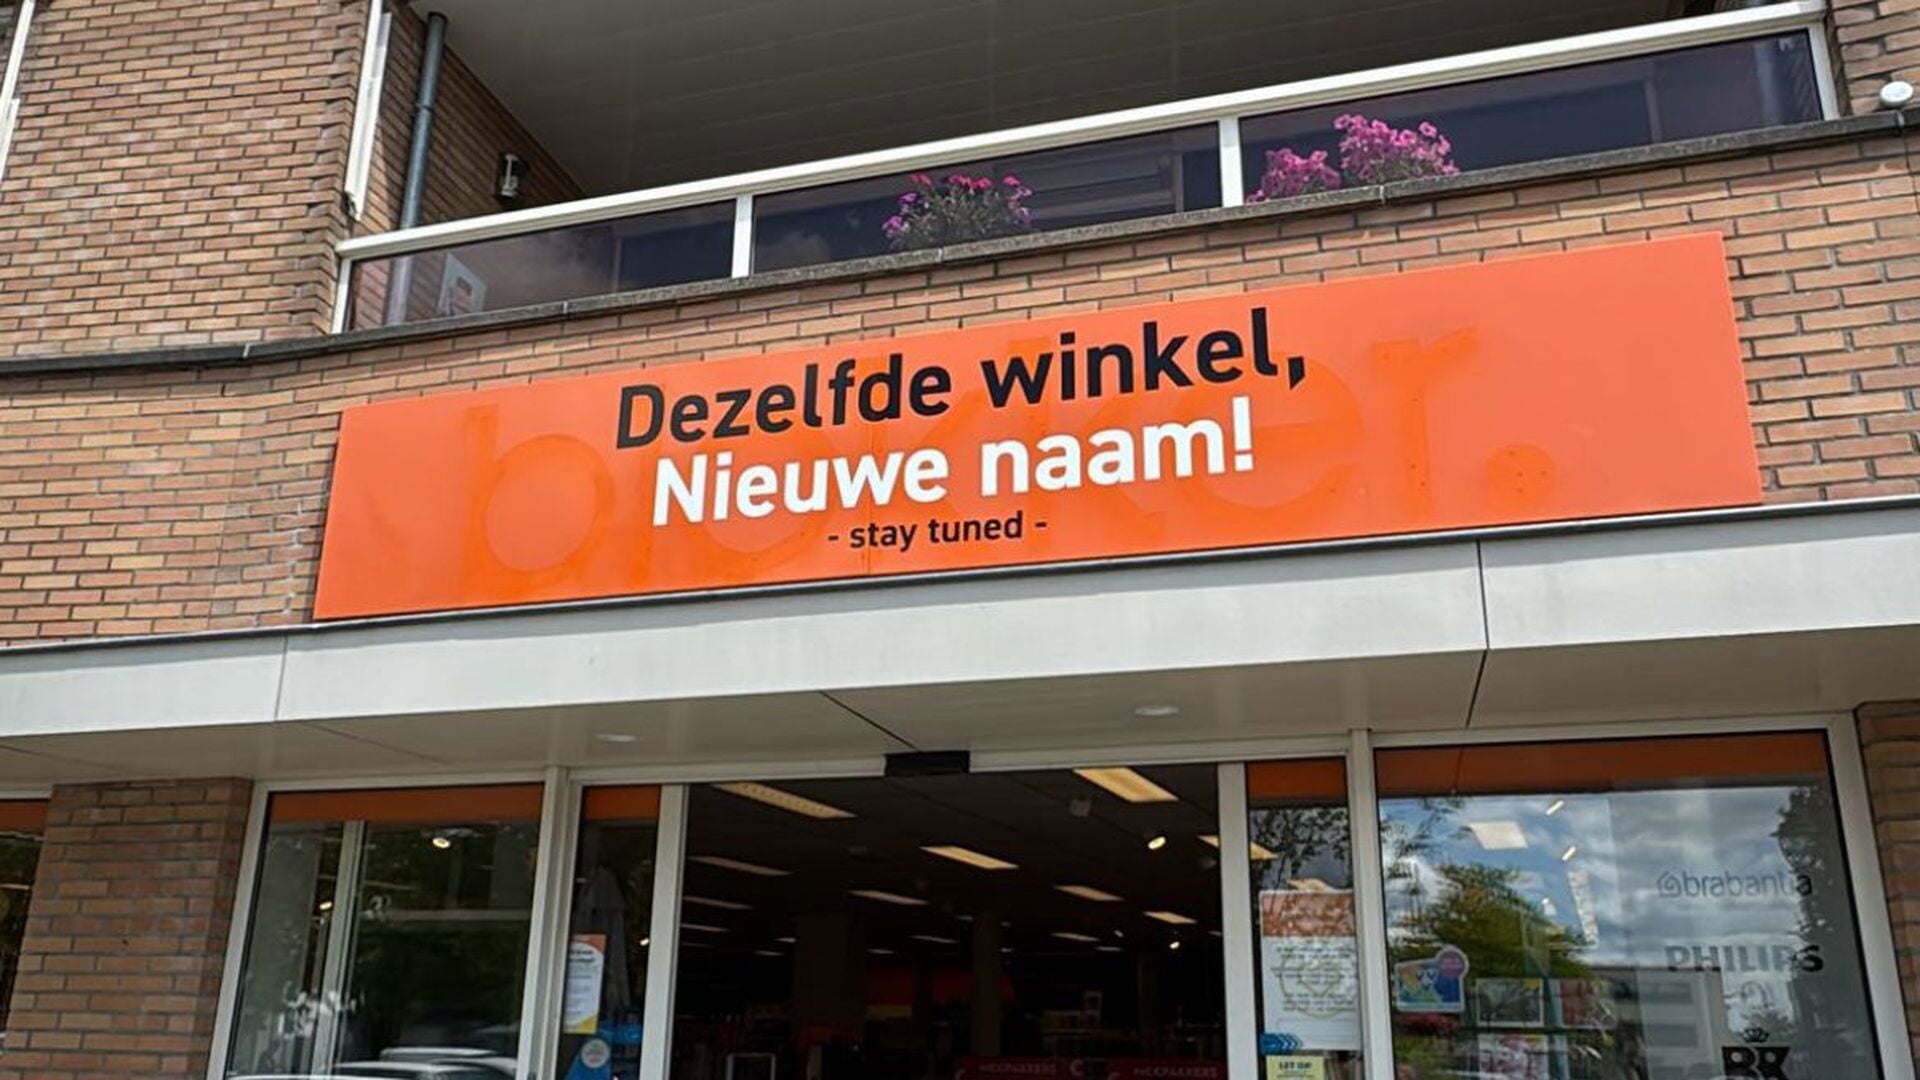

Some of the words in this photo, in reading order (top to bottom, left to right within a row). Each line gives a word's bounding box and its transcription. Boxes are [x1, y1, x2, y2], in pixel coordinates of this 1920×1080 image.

[616, 352, 952, 449] Dezelfde
[980, 306, 1306, 409] winkel,
[652, 448, 950, 526] Nieuwe
[981, 395, 1254, 497] naam!
[849, 522, 918, 553] stay
[929, 510, 1023, 543] tuned
[1682, 869, 1813, 898] brabanta
[1664, 944, 1824, 973] PHILIPS
